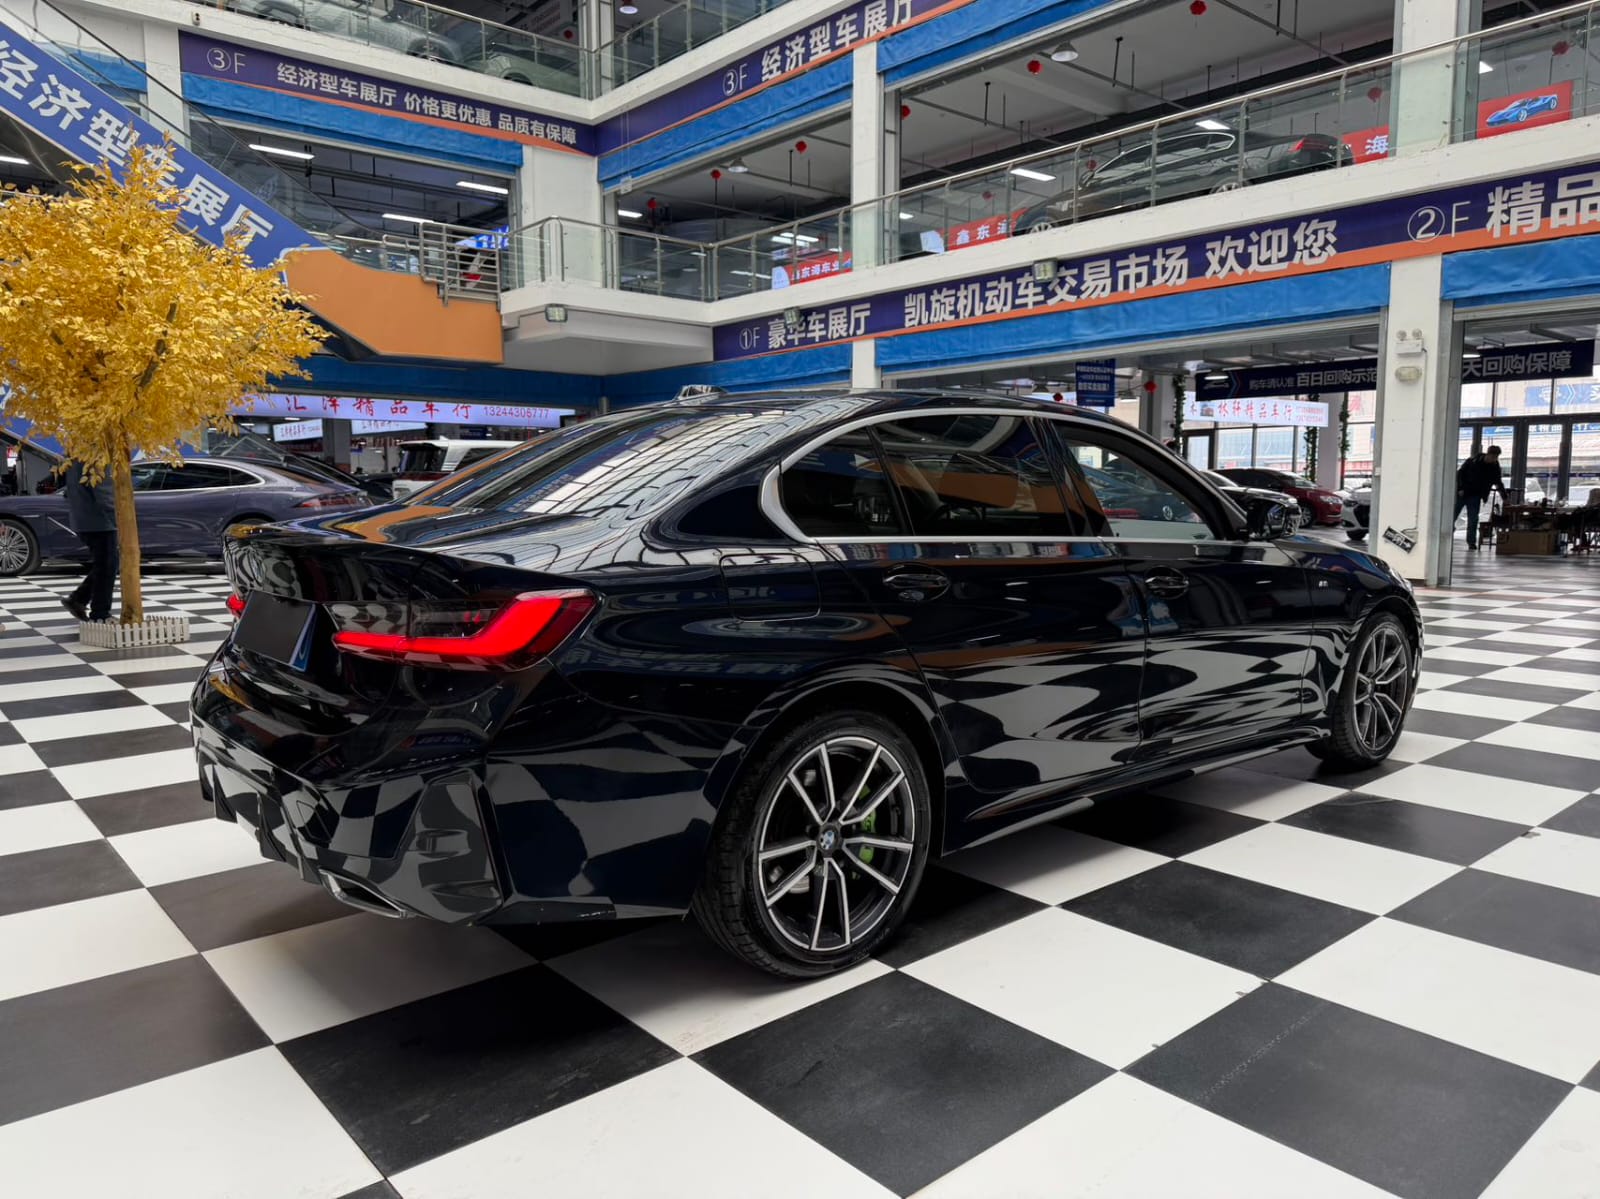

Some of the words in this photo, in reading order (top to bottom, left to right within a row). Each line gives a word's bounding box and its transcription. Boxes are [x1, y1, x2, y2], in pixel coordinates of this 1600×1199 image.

[761, 0, 913, 82] 经济型车展厅
[277, 62, 397, 107] 经济型车展厅
[404, 91, 491, 127] 价格更优惠
[498, 113, 577, 145] 品质有保障
[1487, 171, 1600, 239] 精品
[767, 303, 871, 349] 豪华车展厅
[904, 244, 1189, 327] 凯旋机动车交易市场
[1204, 219, 1338, 280] 欢迎您
